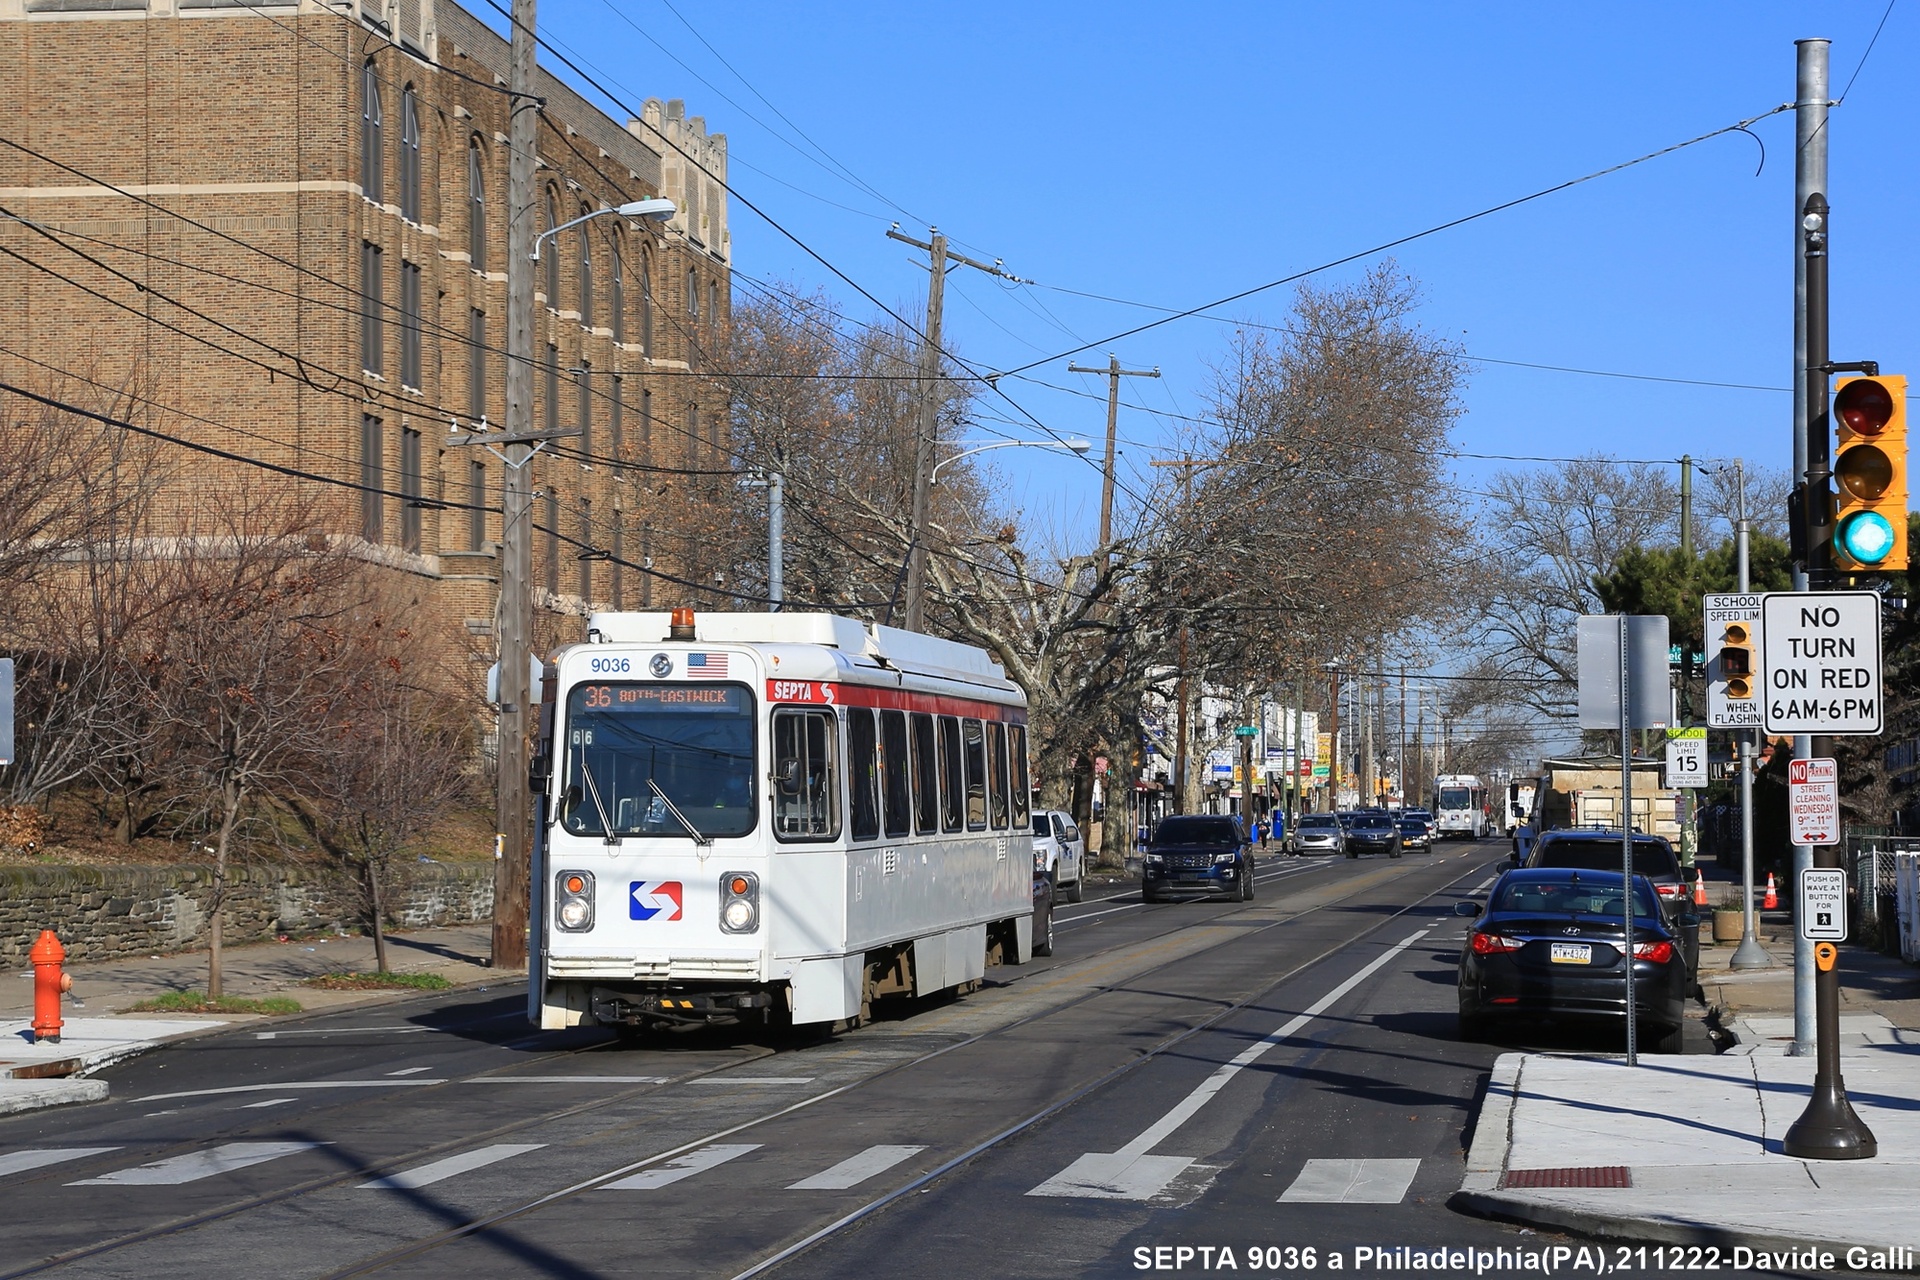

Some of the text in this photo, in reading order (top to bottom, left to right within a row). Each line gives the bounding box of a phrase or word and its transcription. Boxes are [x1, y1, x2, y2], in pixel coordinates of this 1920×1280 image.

[1713, 596, 1761, 607] SCHOOL
[1710, 611, 1740, 621] SPEED
[1801, 607, 1840, 628] NO
[1787, 637, 1855, 658] TURN
[591, 658, 631, 673] 9036
[1773, 668, 1870, 689] ON RED
[585, 686, 611, 707] 36
[774, 681, 811, 700] SEPTA
[1726, 702, 1757, 713] WHEN
[1771, 699, 1874, 720] 6AM-6PM
[1677, 756, 1697, 771] 15
[1791, 764, 1833, 780] NO PARKING
[1800, 785, 1826, 793] STREET
[1795, 794, 1831, 803] CLEANING
[1793, 803, 1834, 814] WEDNESDAY
